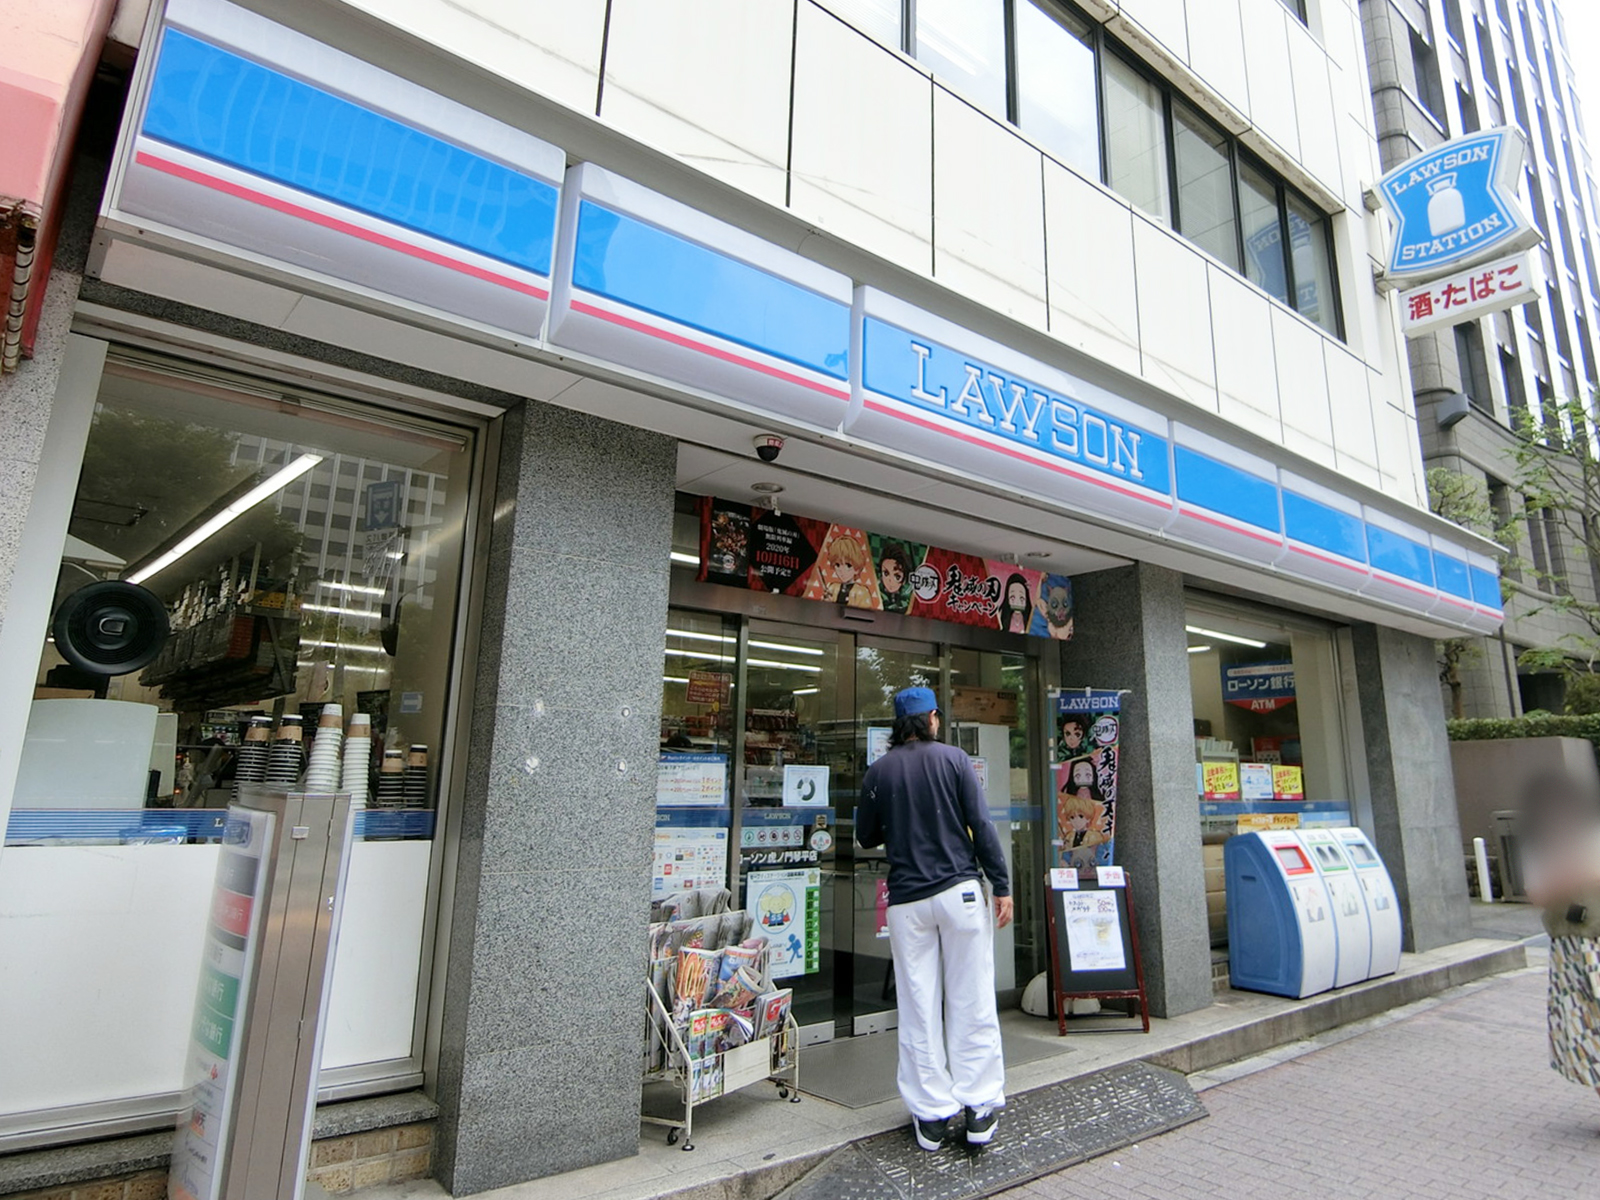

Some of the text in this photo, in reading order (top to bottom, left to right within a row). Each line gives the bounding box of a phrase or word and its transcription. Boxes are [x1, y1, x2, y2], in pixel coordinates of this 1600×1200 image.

[1391, 145, 1491, 196] LAWSON
[1401, 213, 1503, 261] STATION
[911, 341, 1143, 480] LAWSON
[766, 542, 790, 554] 2020年
[756, 550, 799, 569] 10月16日
[943, 564, 1000, 603] 鬼滅の刃
[946, 594, 999, 617] キャンペーン
[1227, 675, 1296, 692] ローソン銀行
[1059, 696, 1119, 710] LAWSON
[1250, 699, 1276, 710] ATM
